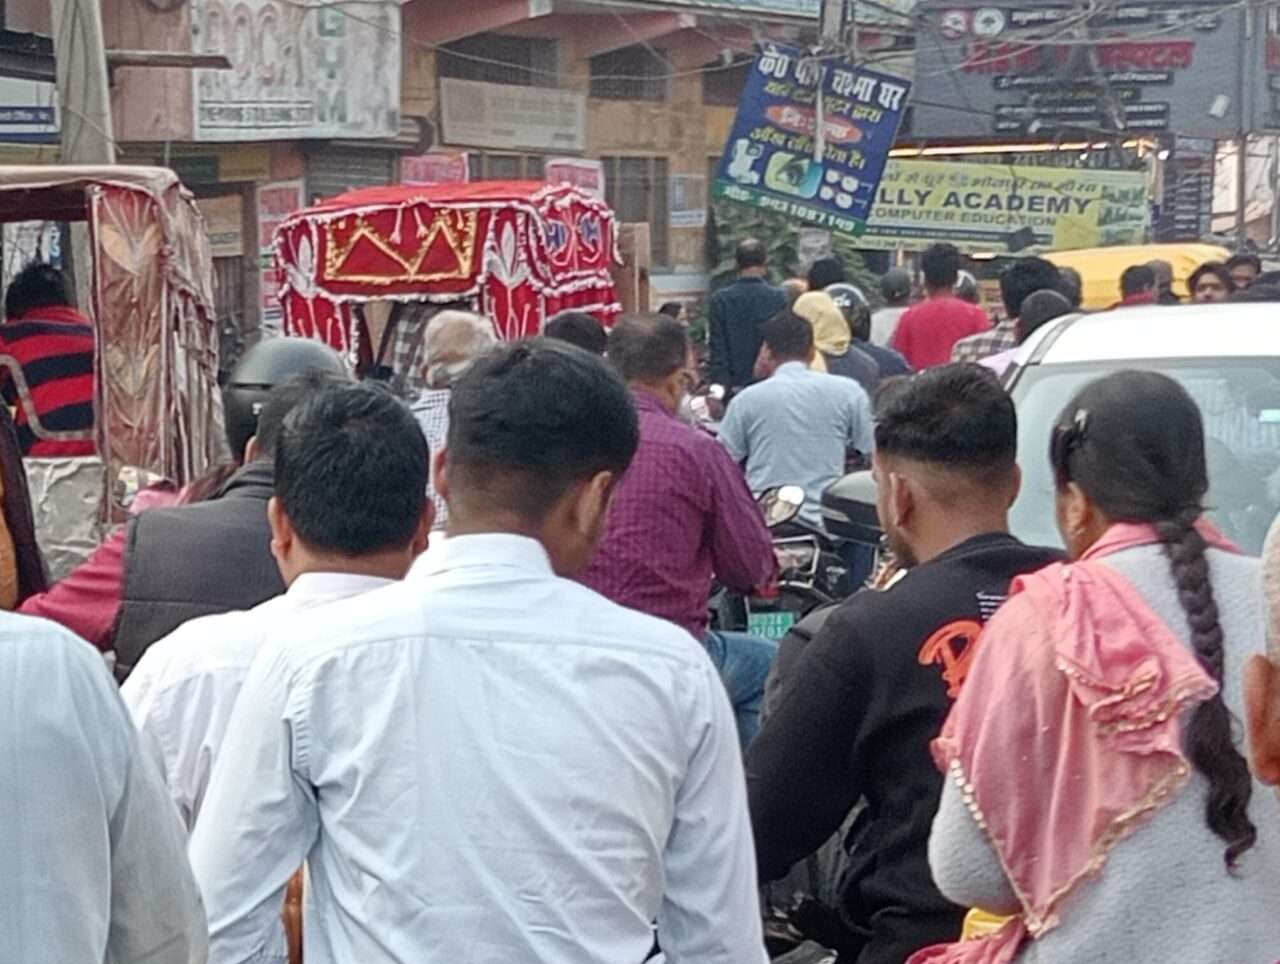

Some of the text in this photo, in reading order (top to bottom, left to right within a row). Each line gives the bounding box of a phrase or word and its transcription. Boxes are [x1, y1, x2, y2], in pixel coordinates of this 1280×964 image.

[831, 68, 877, 103] चश्मा
[877, 82, 906, 112] घर
[942, 188, 1093, 215] ACADEMY
[874, 205, 1057, 227] OMPUTER EDUCATION
